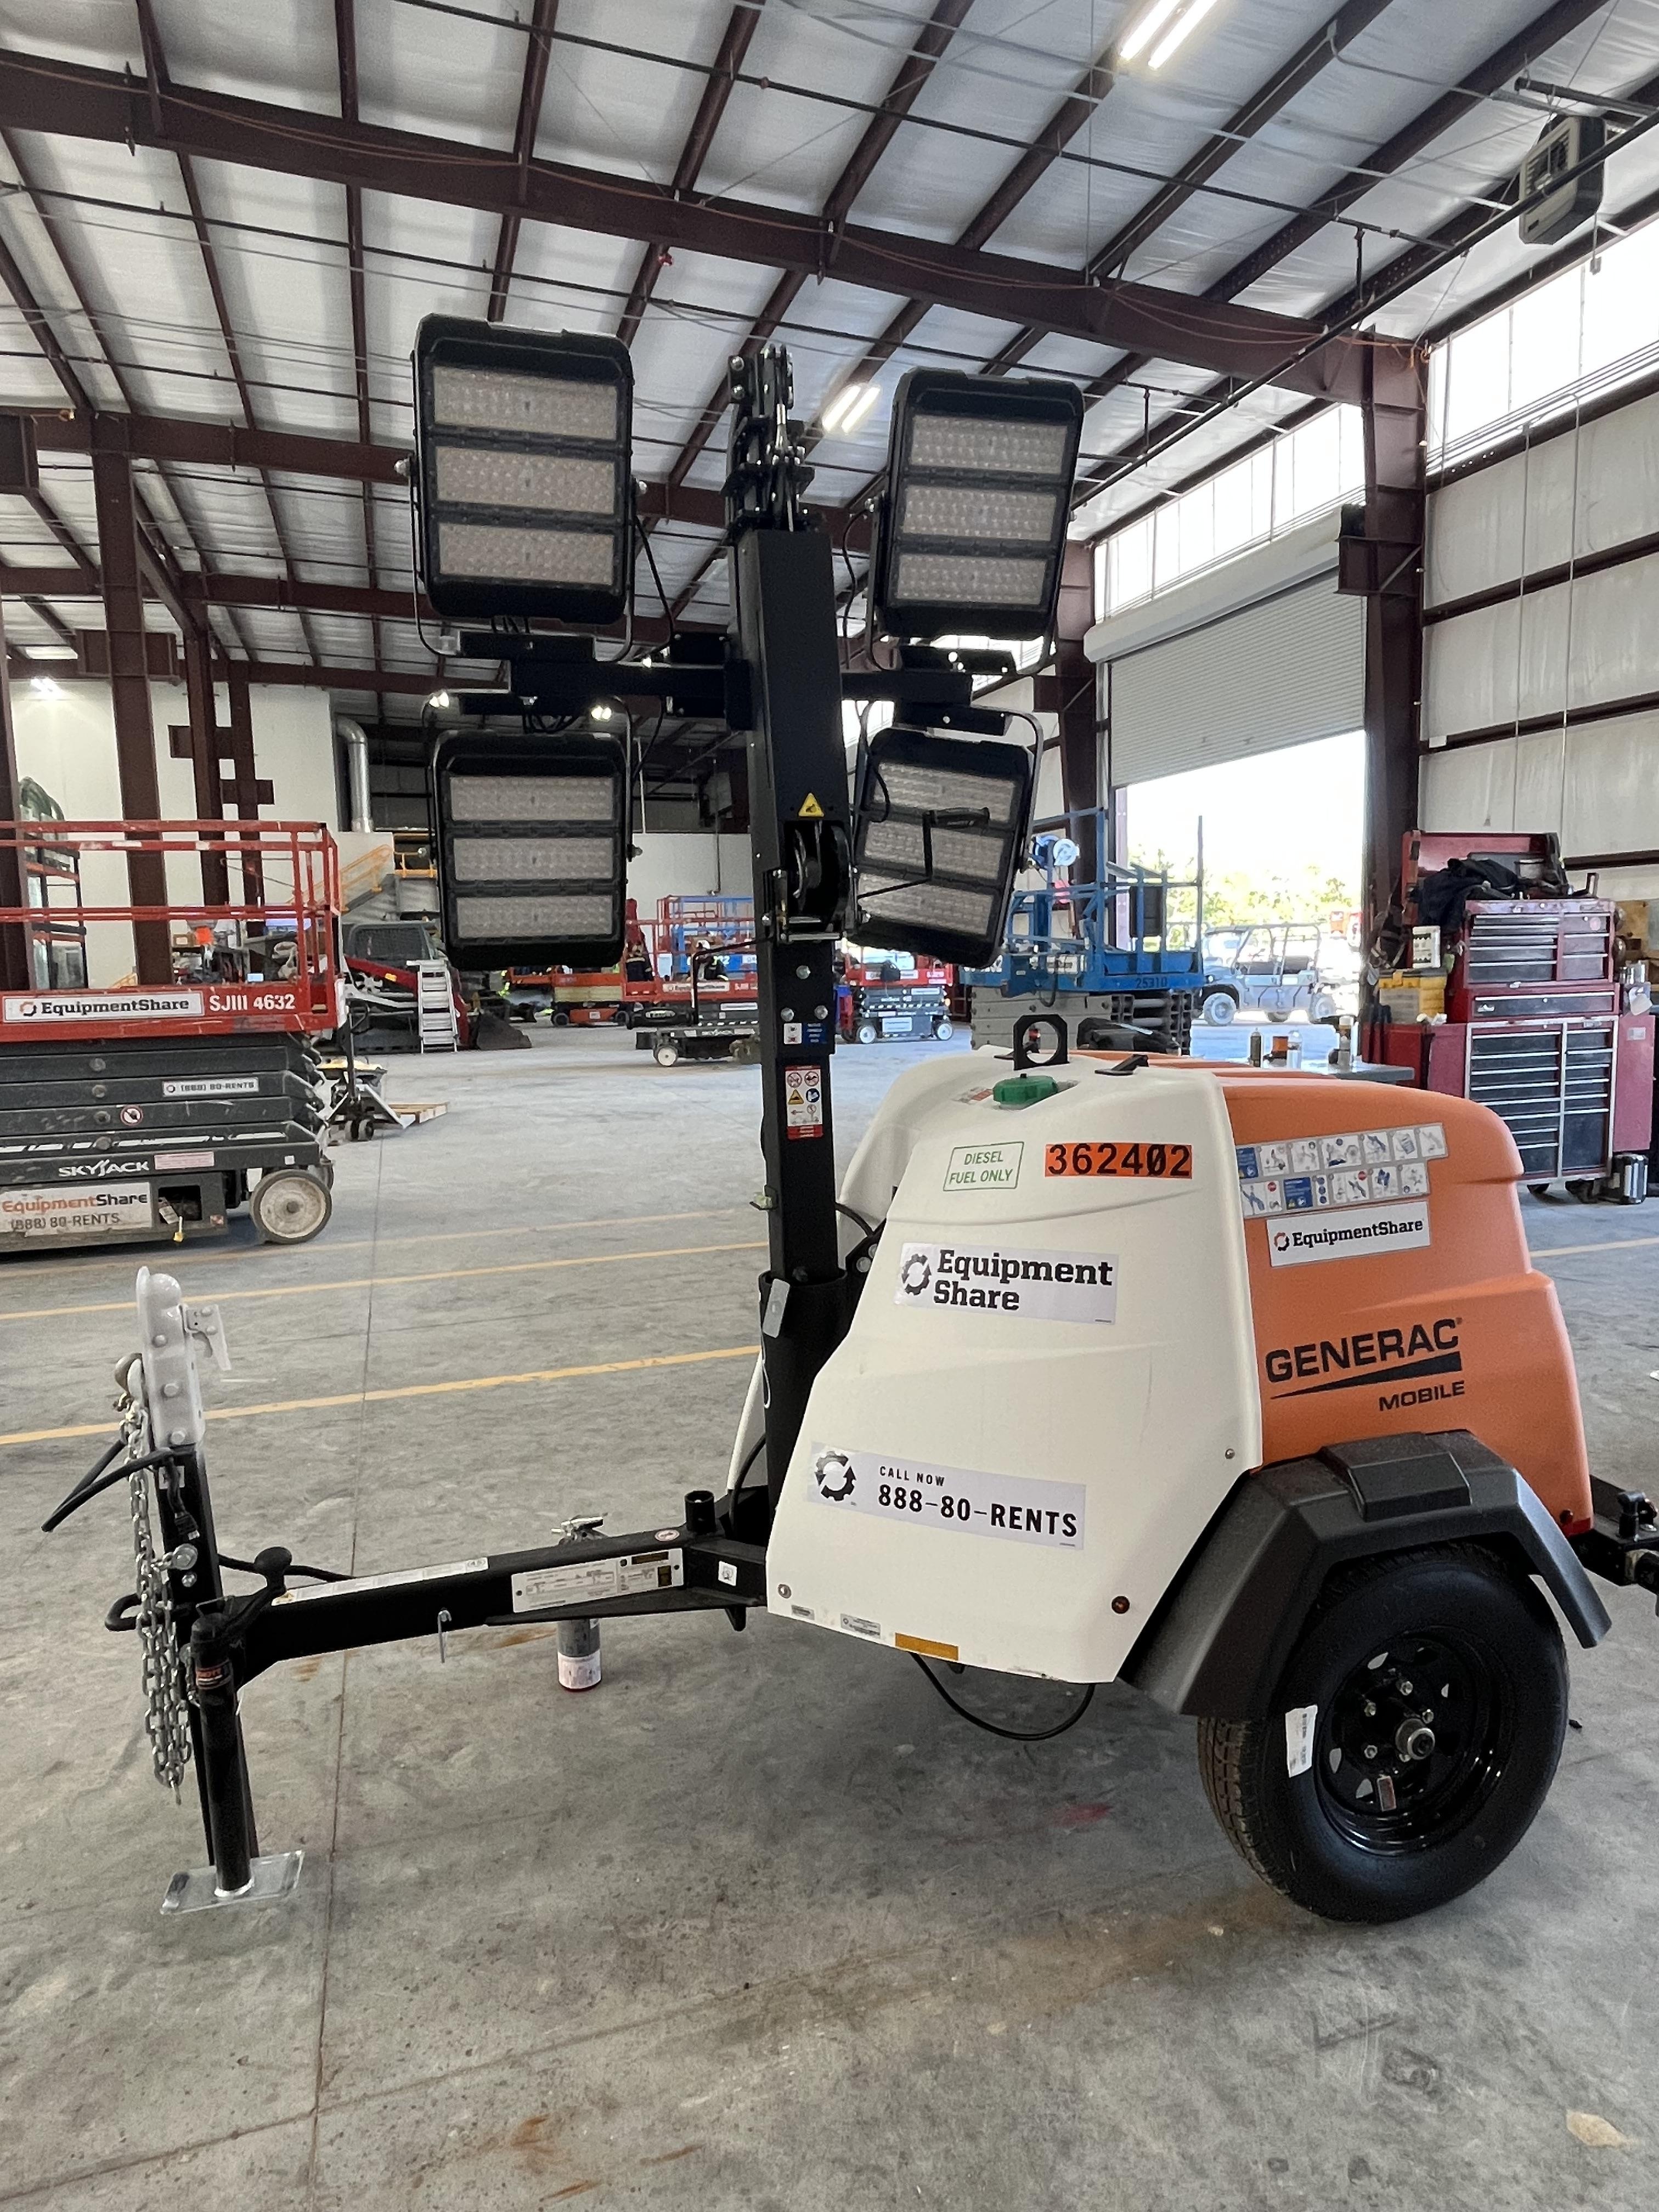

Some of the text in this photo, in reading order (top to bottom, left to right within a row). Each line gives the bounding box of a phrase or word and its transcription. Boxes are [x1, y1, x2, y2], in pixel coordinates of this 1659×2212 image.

[41, 999, 189, 1016] EquipmentShare
[252, 994, 296, 1011] 4632
[59, 1159, 149, 1177] SKYJACK
[964, 1150, 1004, 1166] DIESEL
[1048, 1143, 1190, 1177] 362402
[950, 1169, 1013, 1184] FUEL ONLY
[3, 1194, 148, 1215] EquipmentShare
[11, 1212, 120, 1231] (888) 80-RENTS
[1291, 1220, 1424, 1247] EquipmentShare
[937, 1249, 1113, 1286] Equipment
[933, 1280, 1020, 1311] Share
[1265, 1318, 1459, 1383] GENERAC
[1379, 1380, 1465, 1412] MOBILE
[879, 1466, 945, 1487] CALL NOW
[878, 1484, 1077, 1537] 888-80-RENTS
